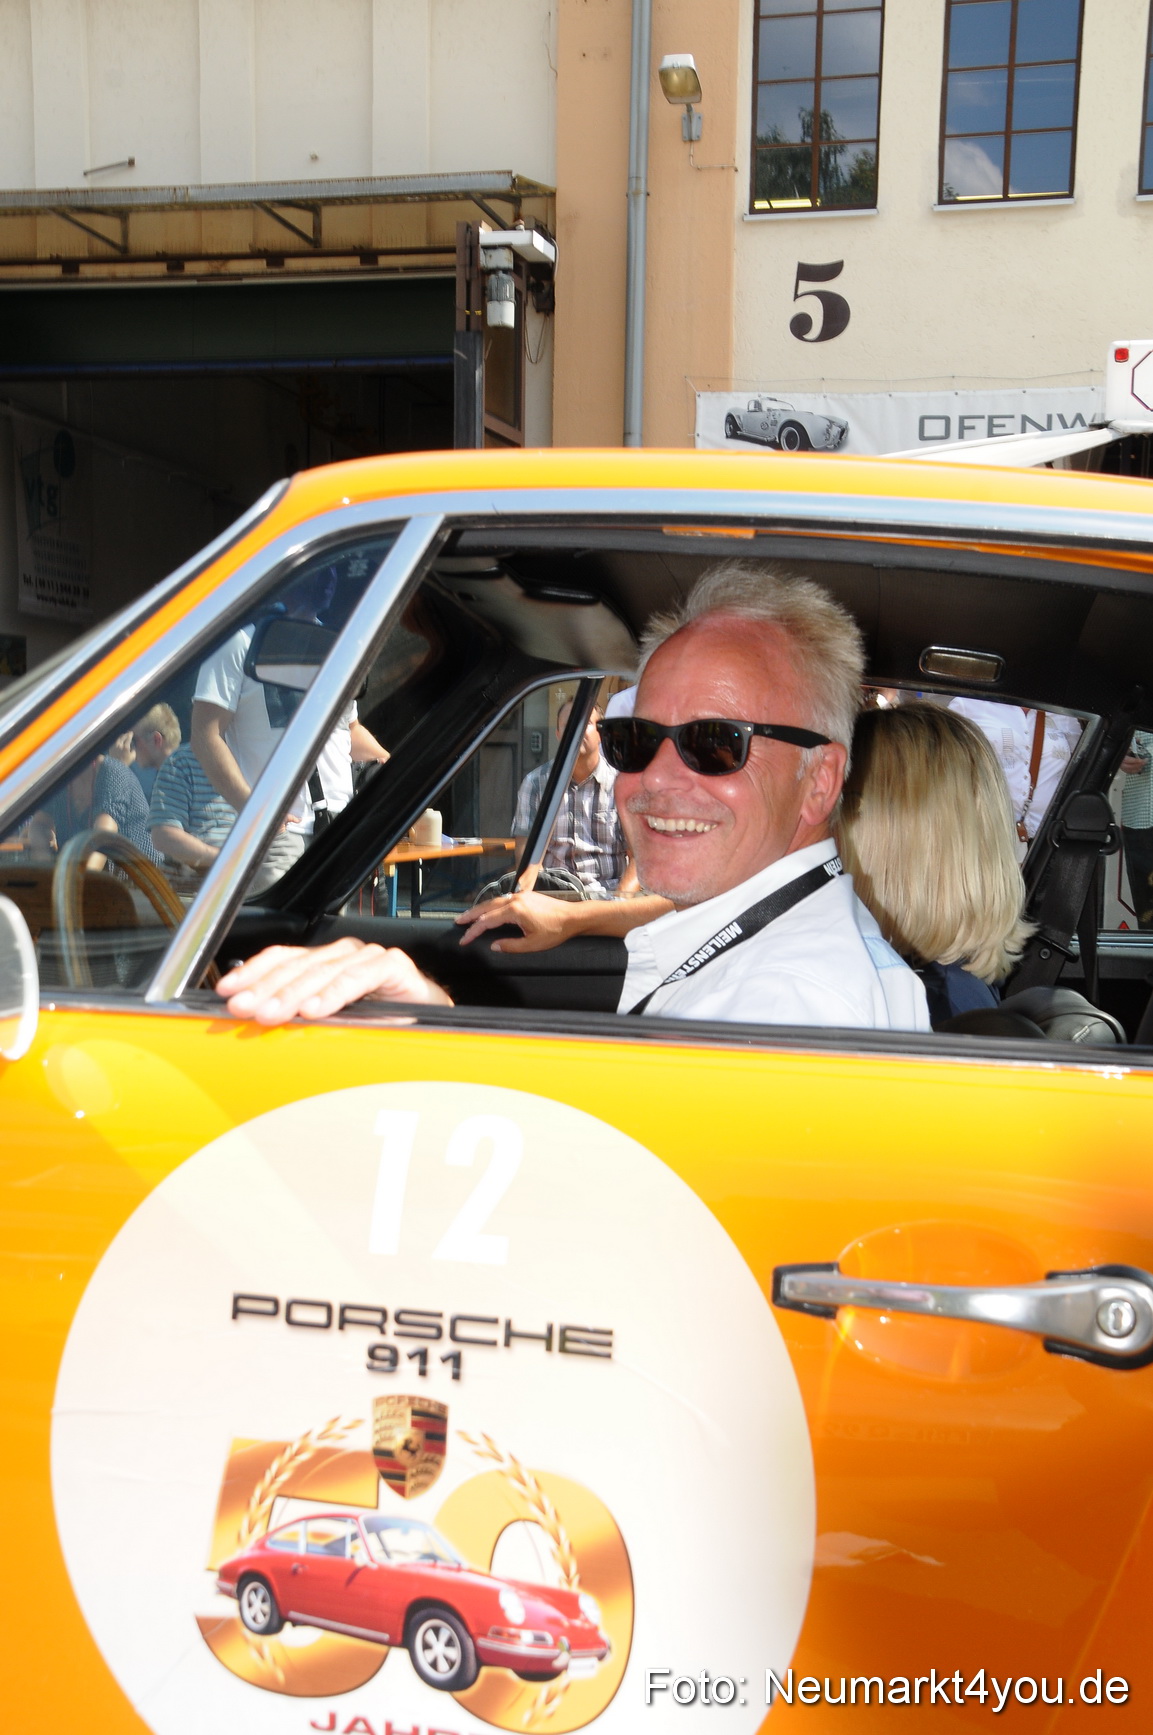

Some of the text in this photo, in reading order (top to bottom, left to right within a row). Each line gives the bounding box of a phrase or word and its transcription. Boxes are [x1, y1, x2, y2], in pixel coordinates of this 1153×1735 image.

[789, 259, 851, 343] 5
[367, 1108, 525, 1266] 12
[231, 1292, 614, 1359] PORSCHE
[366, 1342, 463, 1381] 911
